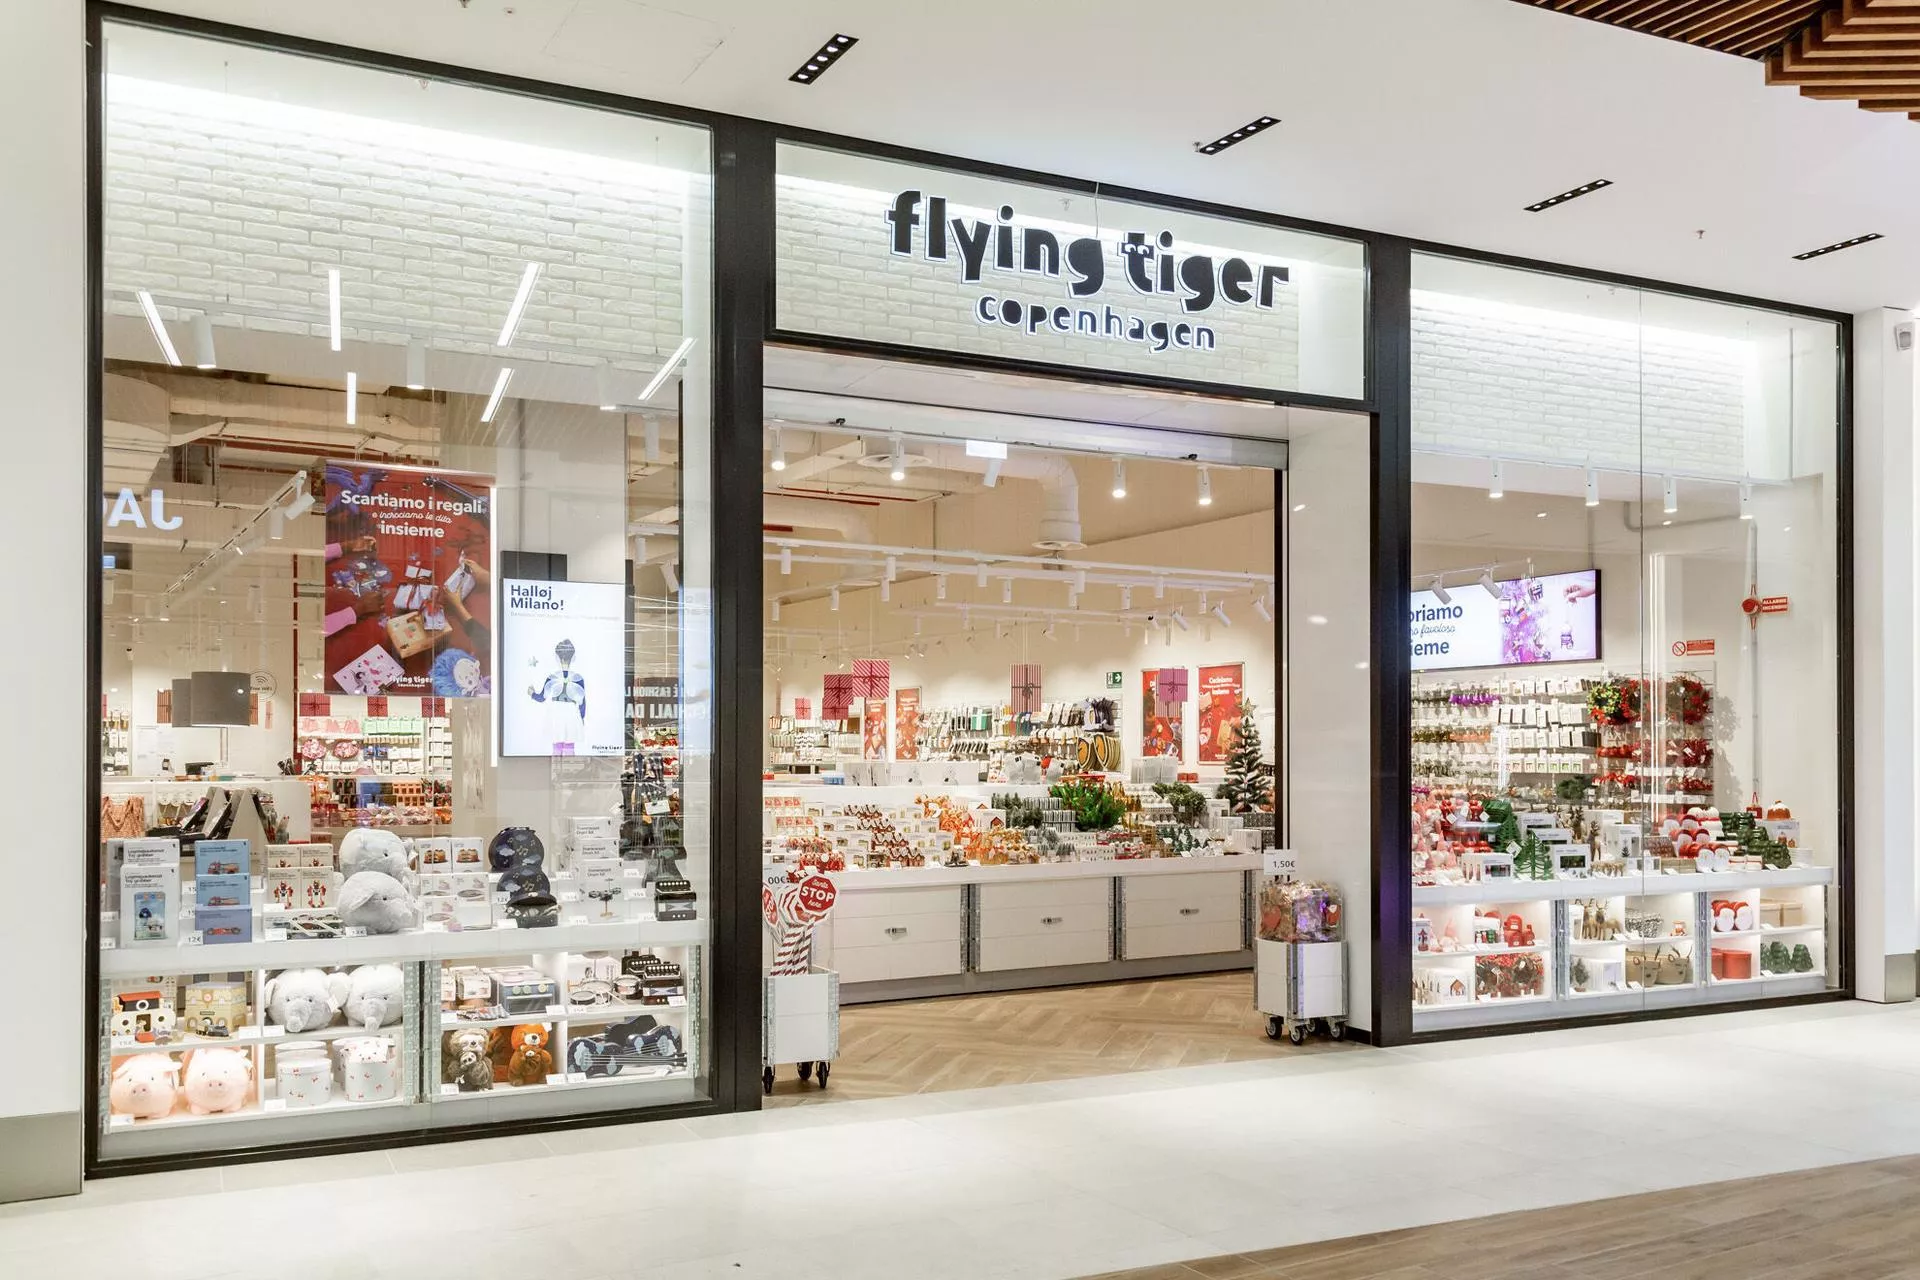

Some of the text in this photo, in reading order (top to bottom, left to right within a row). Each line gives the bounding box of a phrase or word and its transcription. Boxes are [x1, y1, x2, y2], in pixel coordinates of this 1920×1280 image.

[885, 189, 1291, 314] flying tiger
[976, 295, 1217, 354] copenhagen
[341, 490, 425, 509] Scartiamo
[436, 499, 482, 516] regali
[380, 521, 445, 538] insieme
[510, 584, 552, 601] Halløj
[510, 597, 564, 611] Milano!
[1272, 860, 1296, 869] 1,50€
[801, 886, 834, 903] STOP
